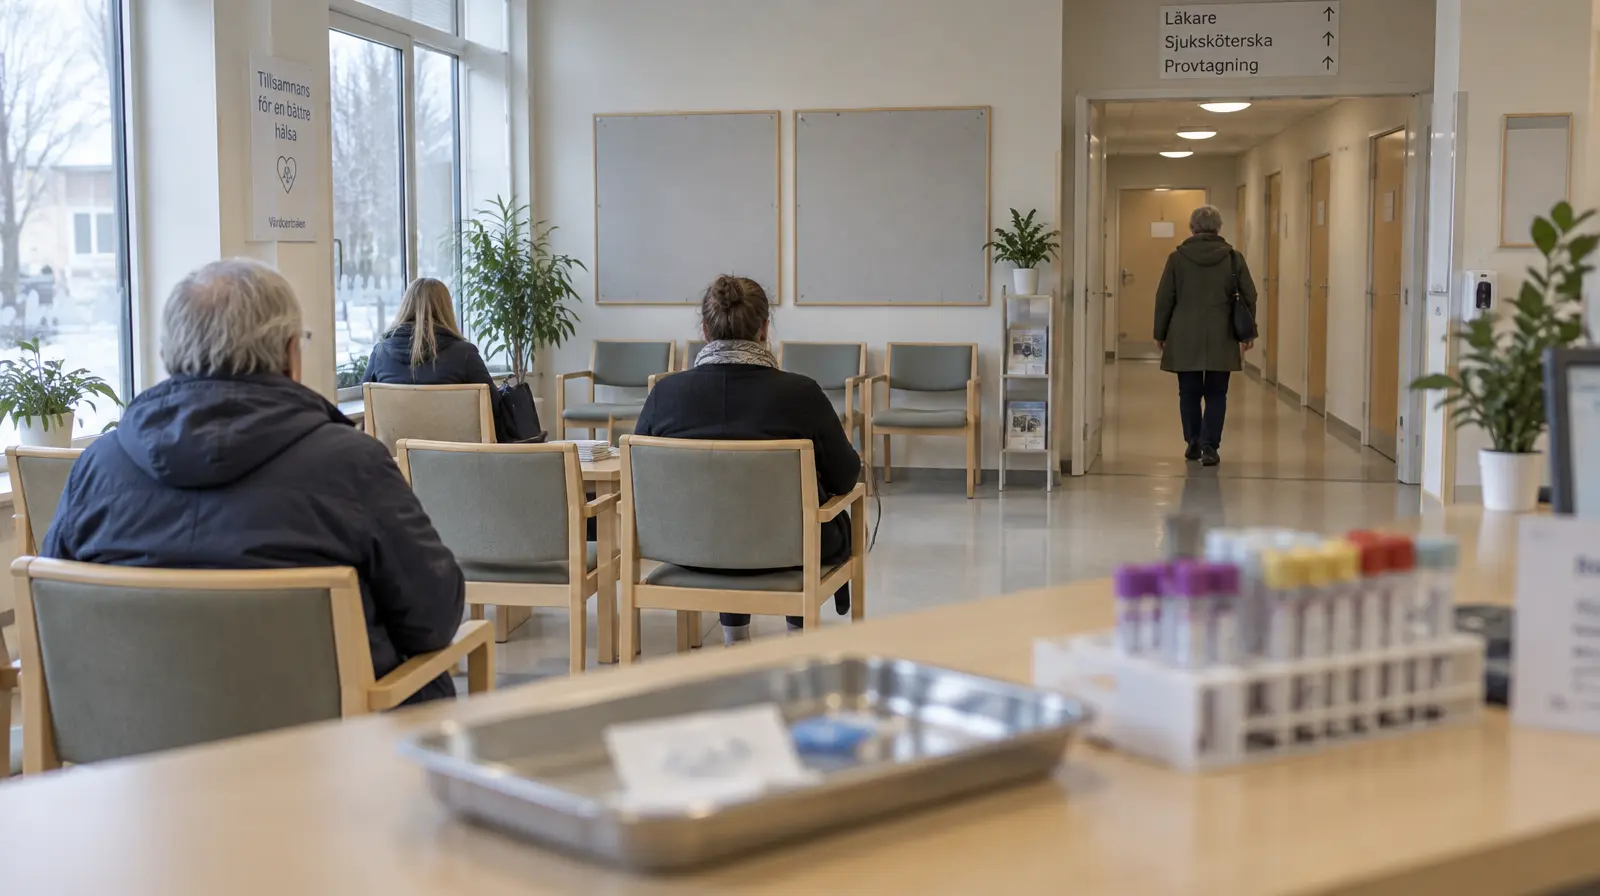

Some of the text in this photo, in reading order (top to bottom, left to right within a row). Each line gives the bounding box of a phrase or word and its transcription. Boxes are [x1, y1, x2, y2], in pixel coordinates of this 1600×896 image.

[1165, 11, 1217, 25] Läkare
[1165, 33, 1273, 52] Sjuksköterska
[1165, 58, 1259, 75] Provtagning
[274, 102, 285, 116] en
